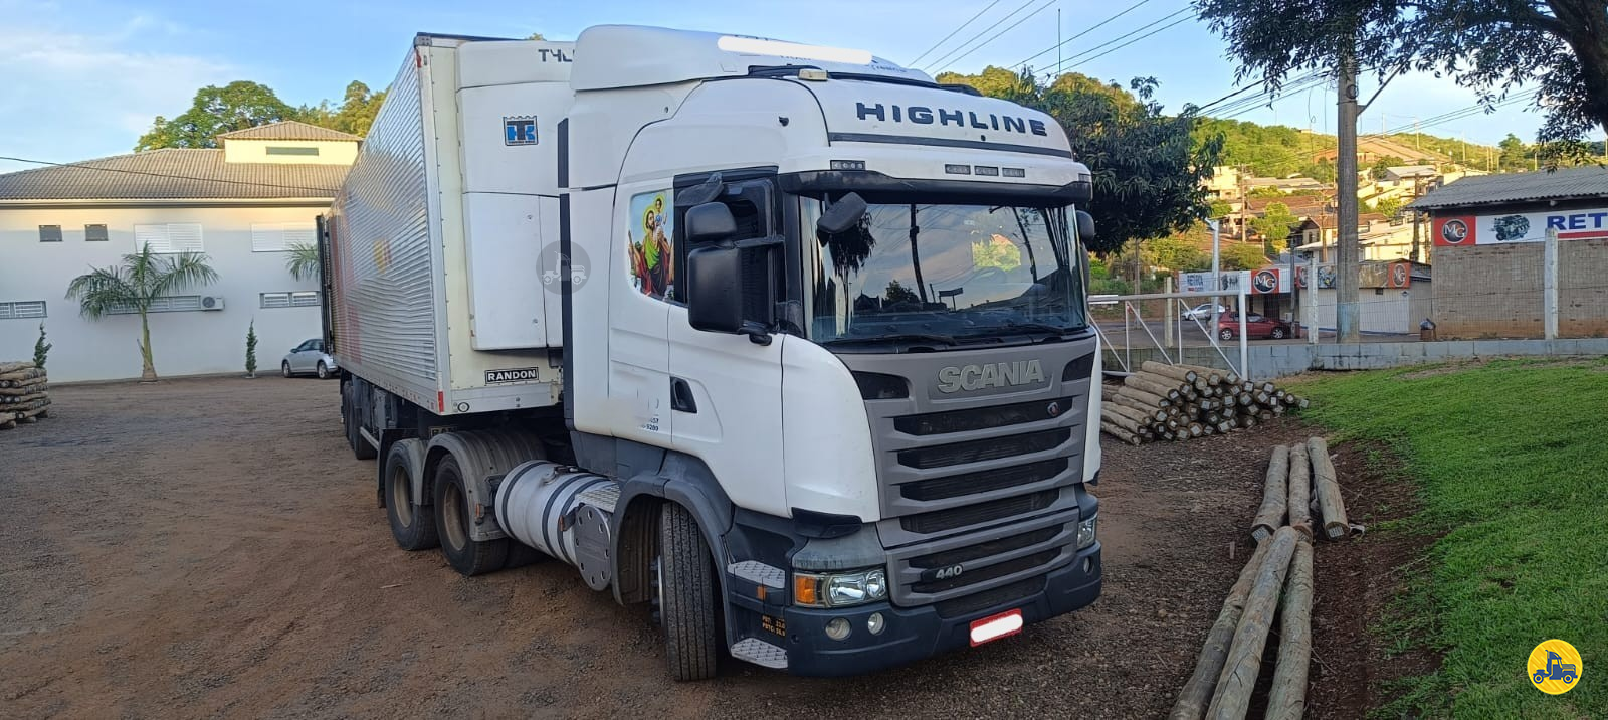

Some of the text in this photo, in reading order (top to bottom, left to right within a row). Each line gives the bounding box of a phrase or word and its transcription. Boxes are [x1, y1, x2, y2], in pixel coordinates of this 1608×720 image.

[856, 103, 1047, 137] HIGHLINE
[1547, 211, 1608, 231] RET
[1443, 223, 1465, 238] MG
[1256, 274, 1276, 289] MG
[487, 369, 537, 381] RANDON
[938, 360, 1045, 393] SCANIA
[936, 565, 963, 579] 440
